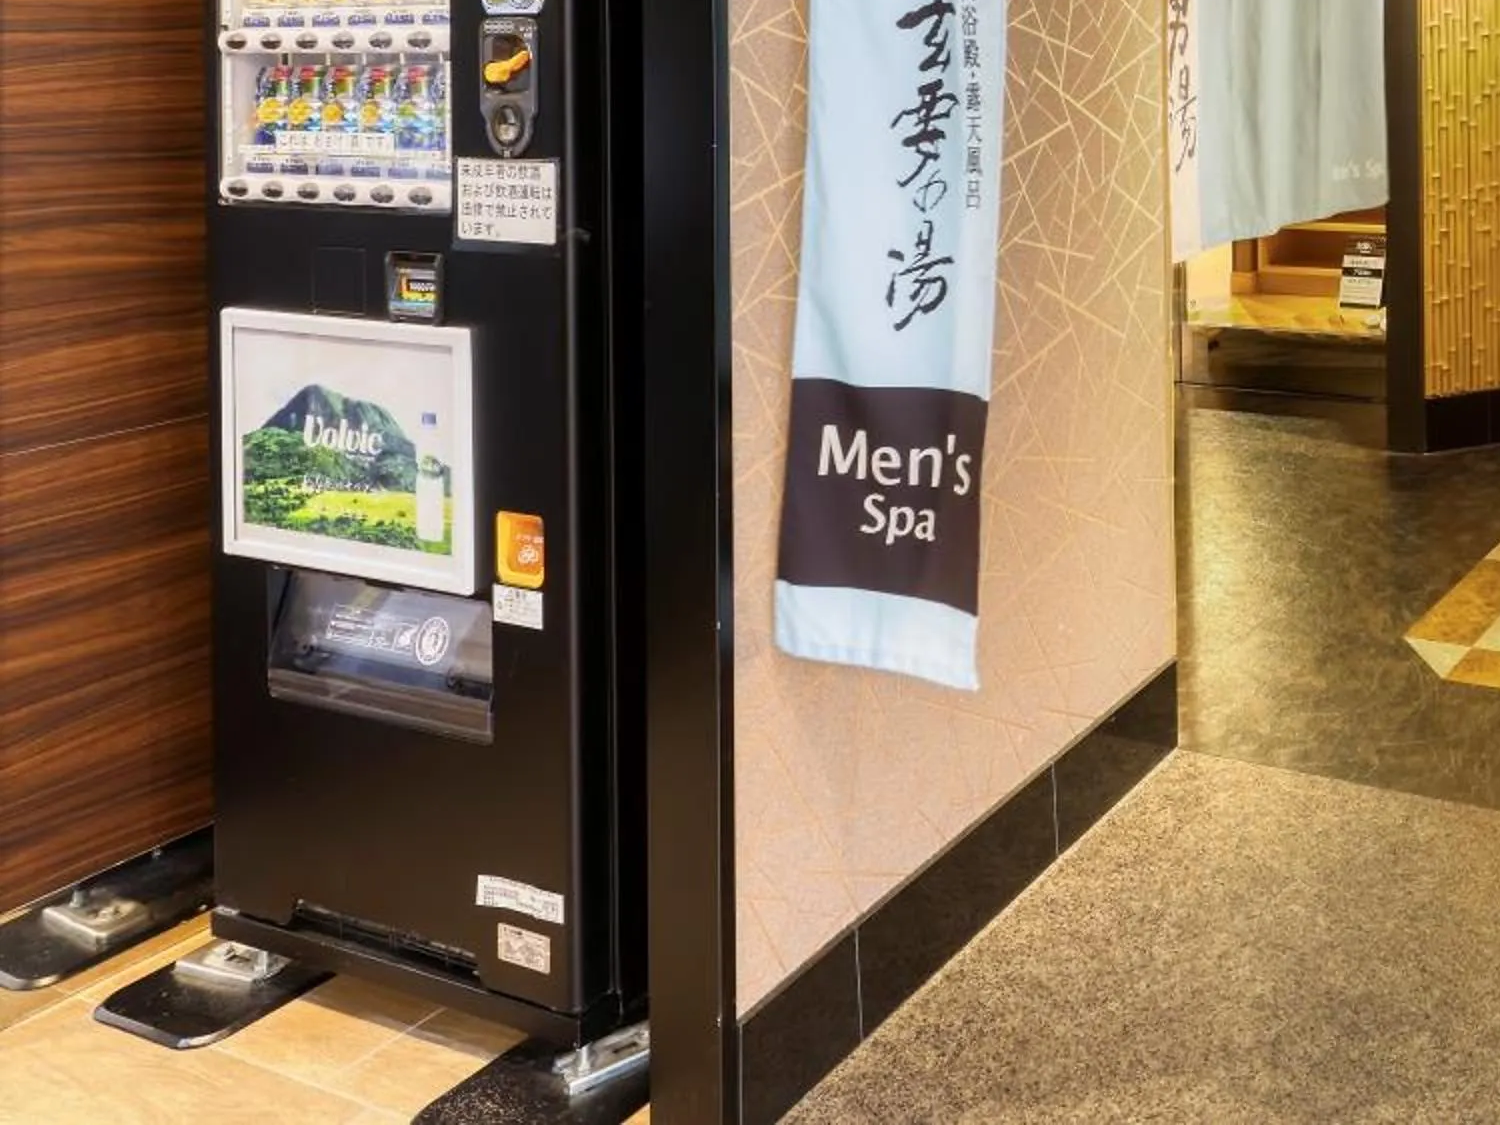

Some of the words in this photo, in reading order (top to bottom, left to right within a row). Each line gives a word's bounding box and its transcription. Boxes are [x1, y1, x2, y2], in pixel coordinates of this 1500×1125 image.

[462, 183, 553, 200] および飲酒運転は
[462, 202, 553, 220] 法律で禁止されて
[303, 414, 383, 455] Volvic
[818, 424, 972, 496] Men's
[860, 492, 936, 546] Spa
